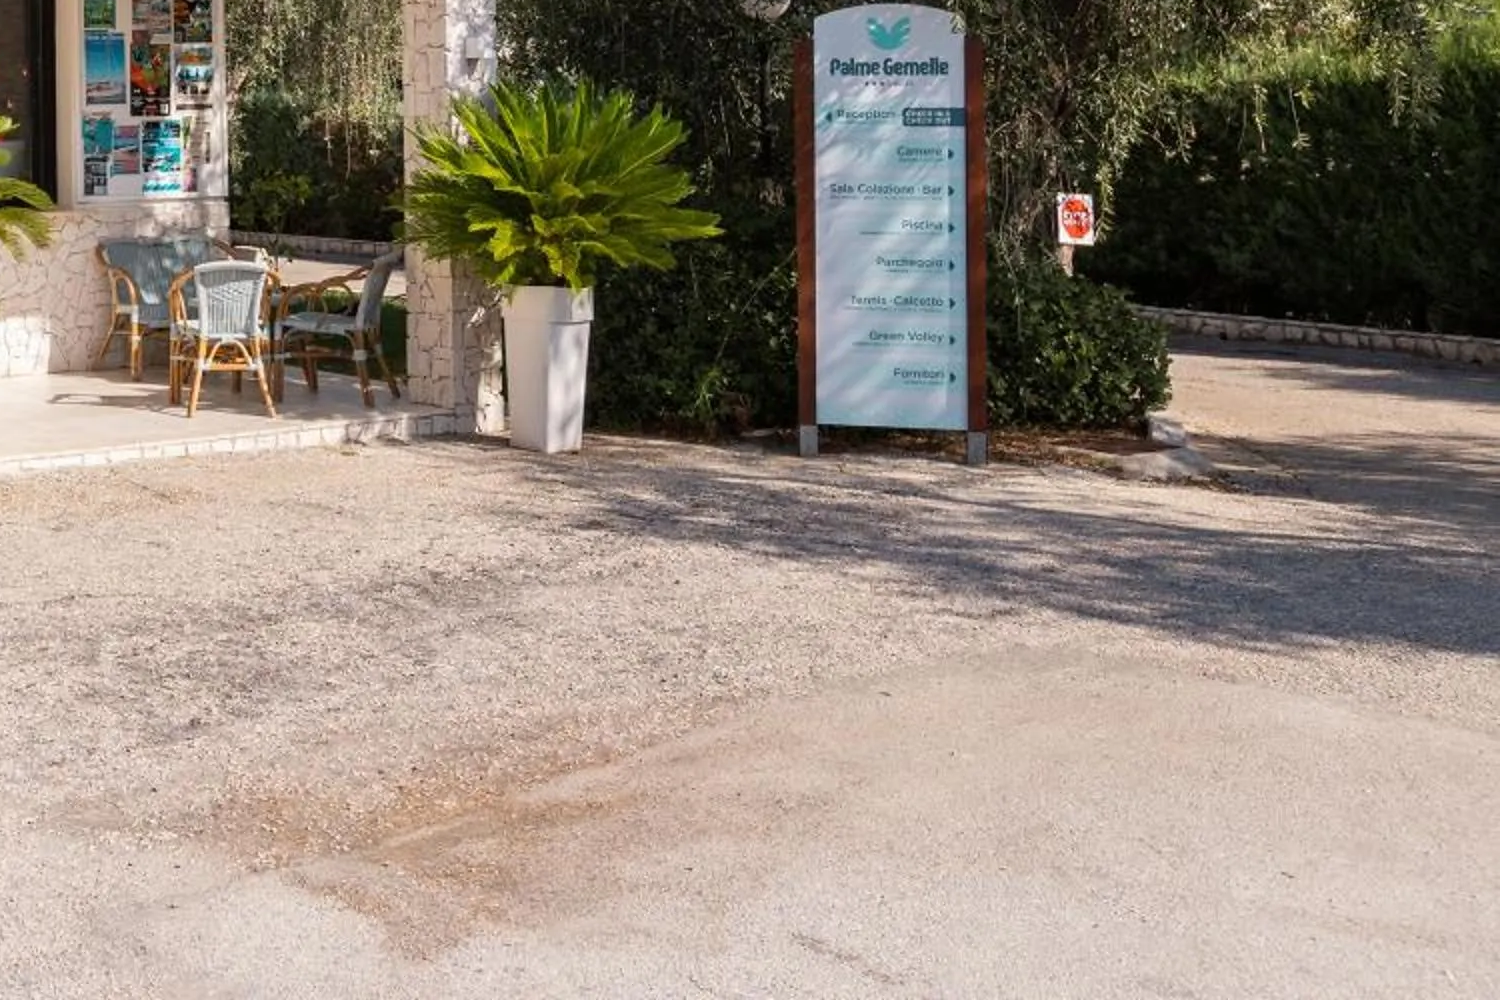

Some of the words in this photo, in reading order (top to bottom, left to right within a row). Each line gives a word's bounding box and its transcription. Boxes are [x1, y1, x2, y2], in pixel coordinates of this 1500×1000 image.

[830, 58, 880, 76] Palme
[883, 57, 949, 76] Gemelle
[837, 110, 895, 121] Reception
[830, 183, 854, 194] Sala
[857, 183, 914, 194] Colazione
[922, 184, 942, 194] Bar
[901, 219, 943, 231] Piscina
[851, 295, 887, 304] Tennis
[894, 295, 943, 306] Calcetto
[869, 329, 905, 340] Green
[907, 330, 944, 343] Volley
